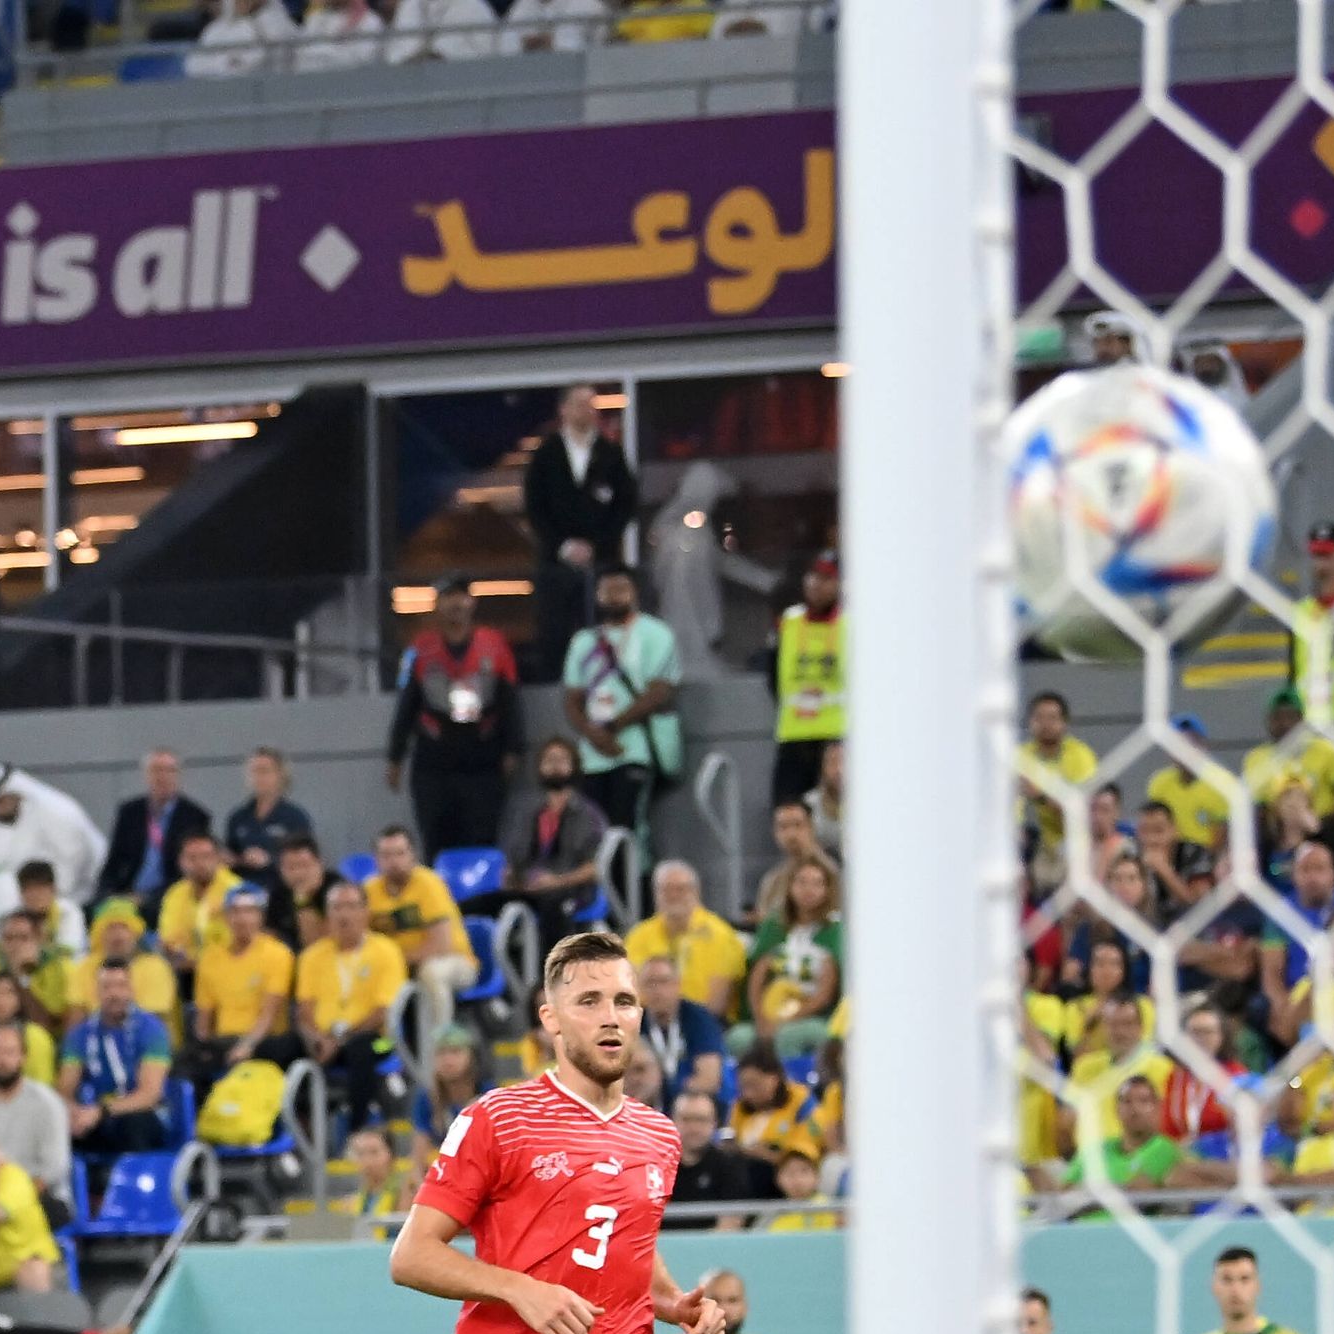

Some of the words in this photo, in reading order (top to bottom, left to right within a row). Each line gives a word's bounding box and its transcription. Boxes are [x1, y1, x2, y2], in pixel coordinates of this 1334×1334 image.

[0, 200, 101, 326] is
[113, 188, 259, 319] all
[571, 1204, 618, 1271] 3
